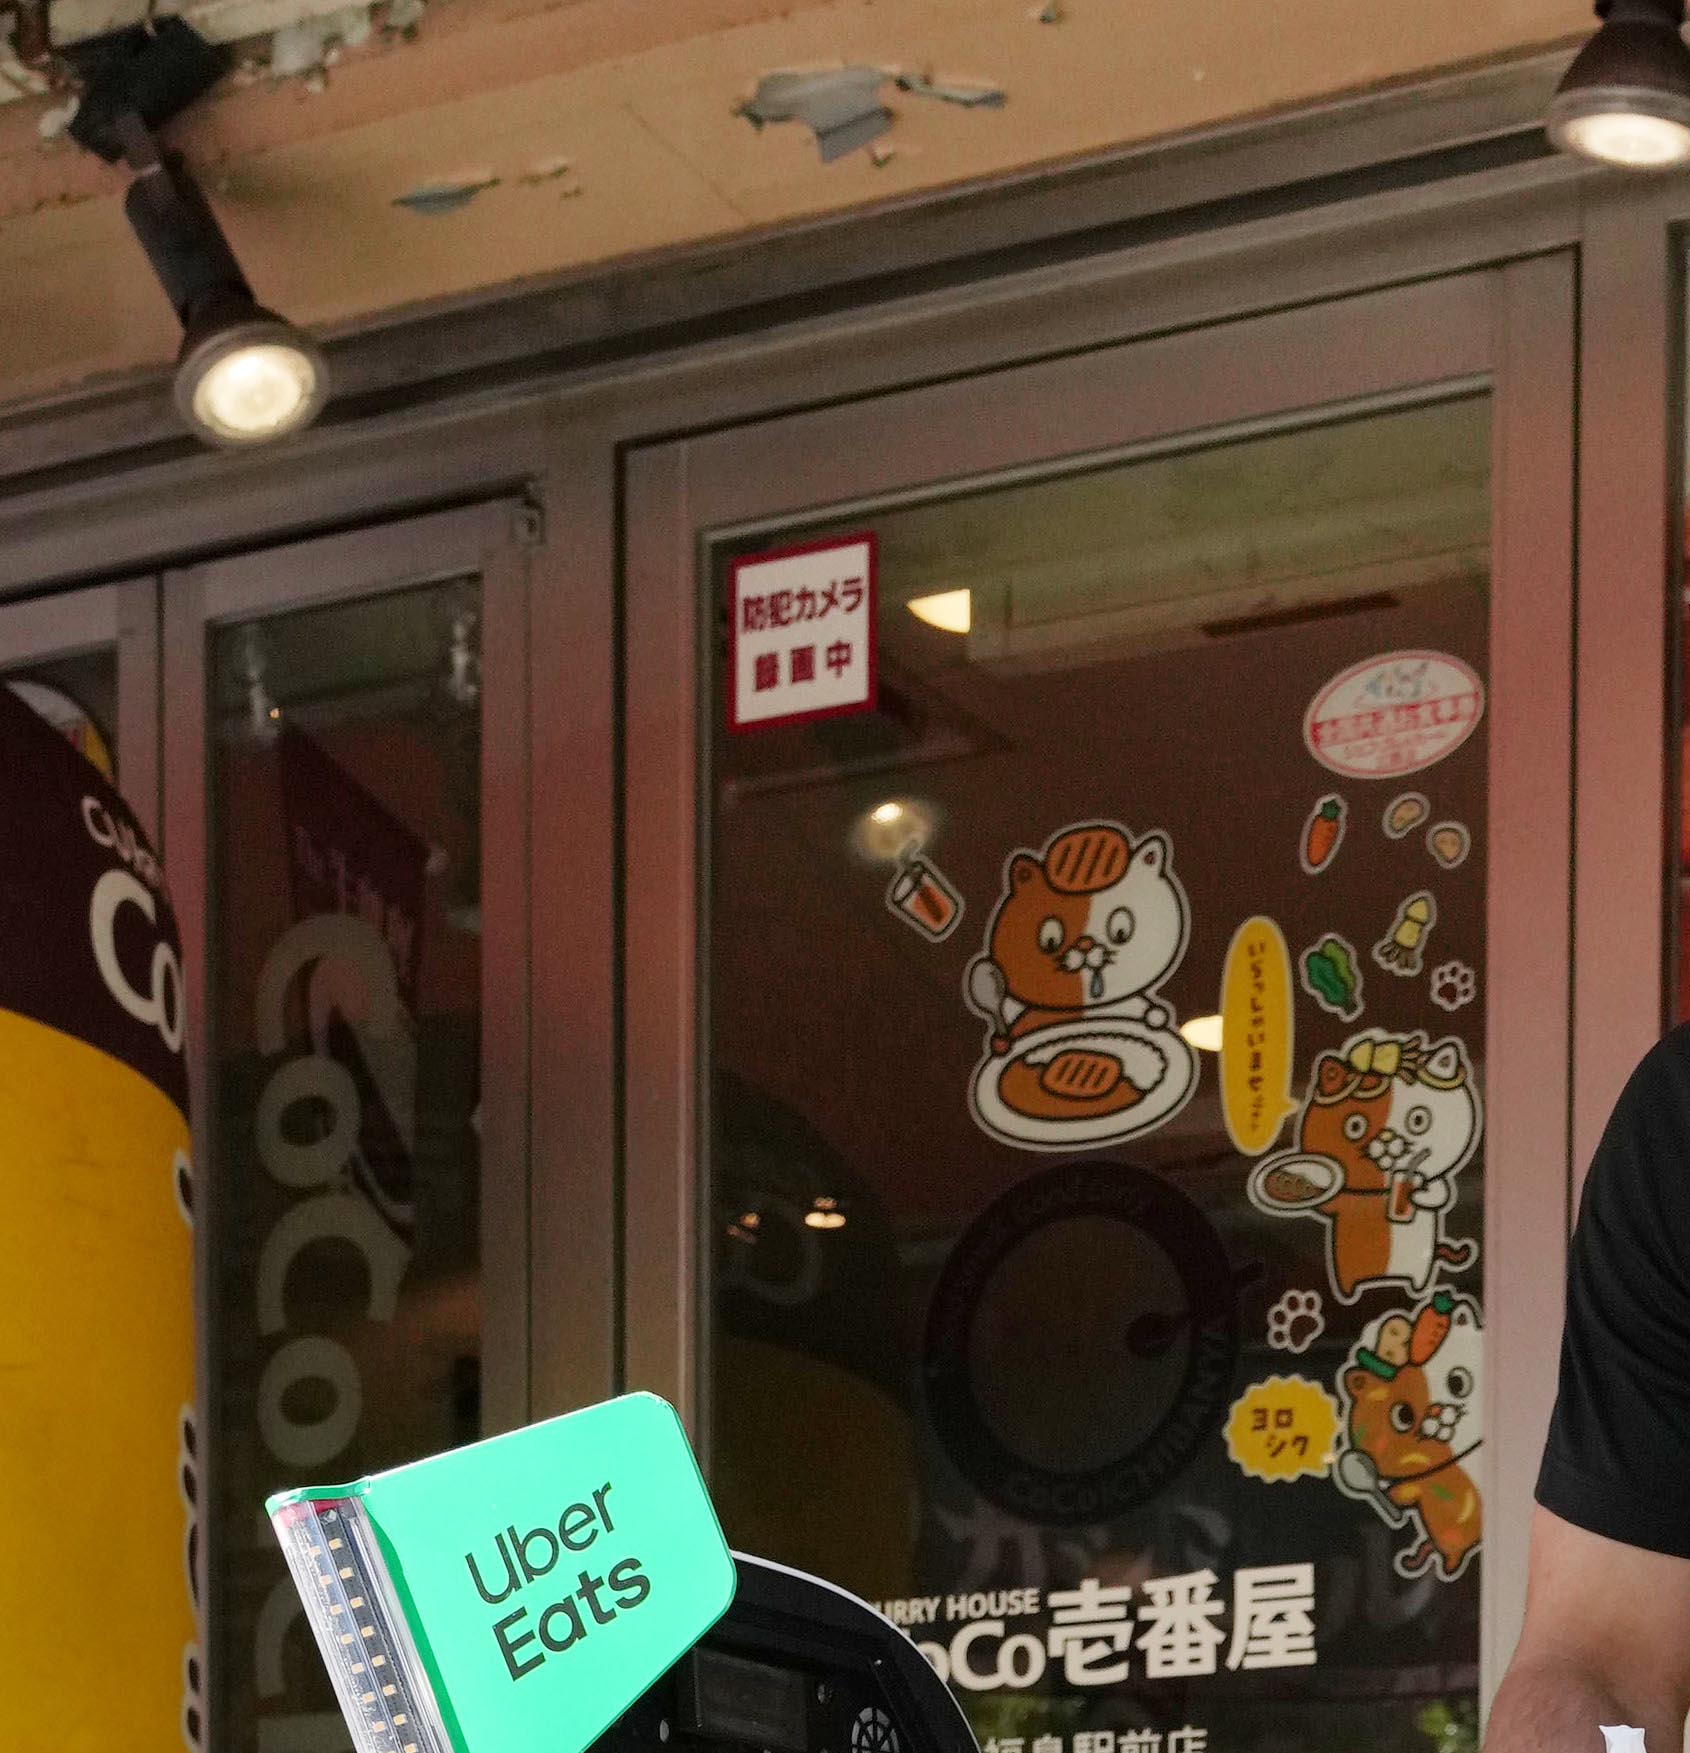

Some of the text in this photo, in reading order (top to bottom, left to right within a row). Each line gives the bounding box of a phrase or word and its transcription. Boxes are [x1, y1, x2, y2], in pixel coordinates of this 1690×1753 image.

[743, 577, 863, 634] 防犯カメラ
[464, 1481, 616, 1605] Uber
[492, 1556, 651, 1683] Eats
[946, 1588, 1040, 1620] HOUSE
